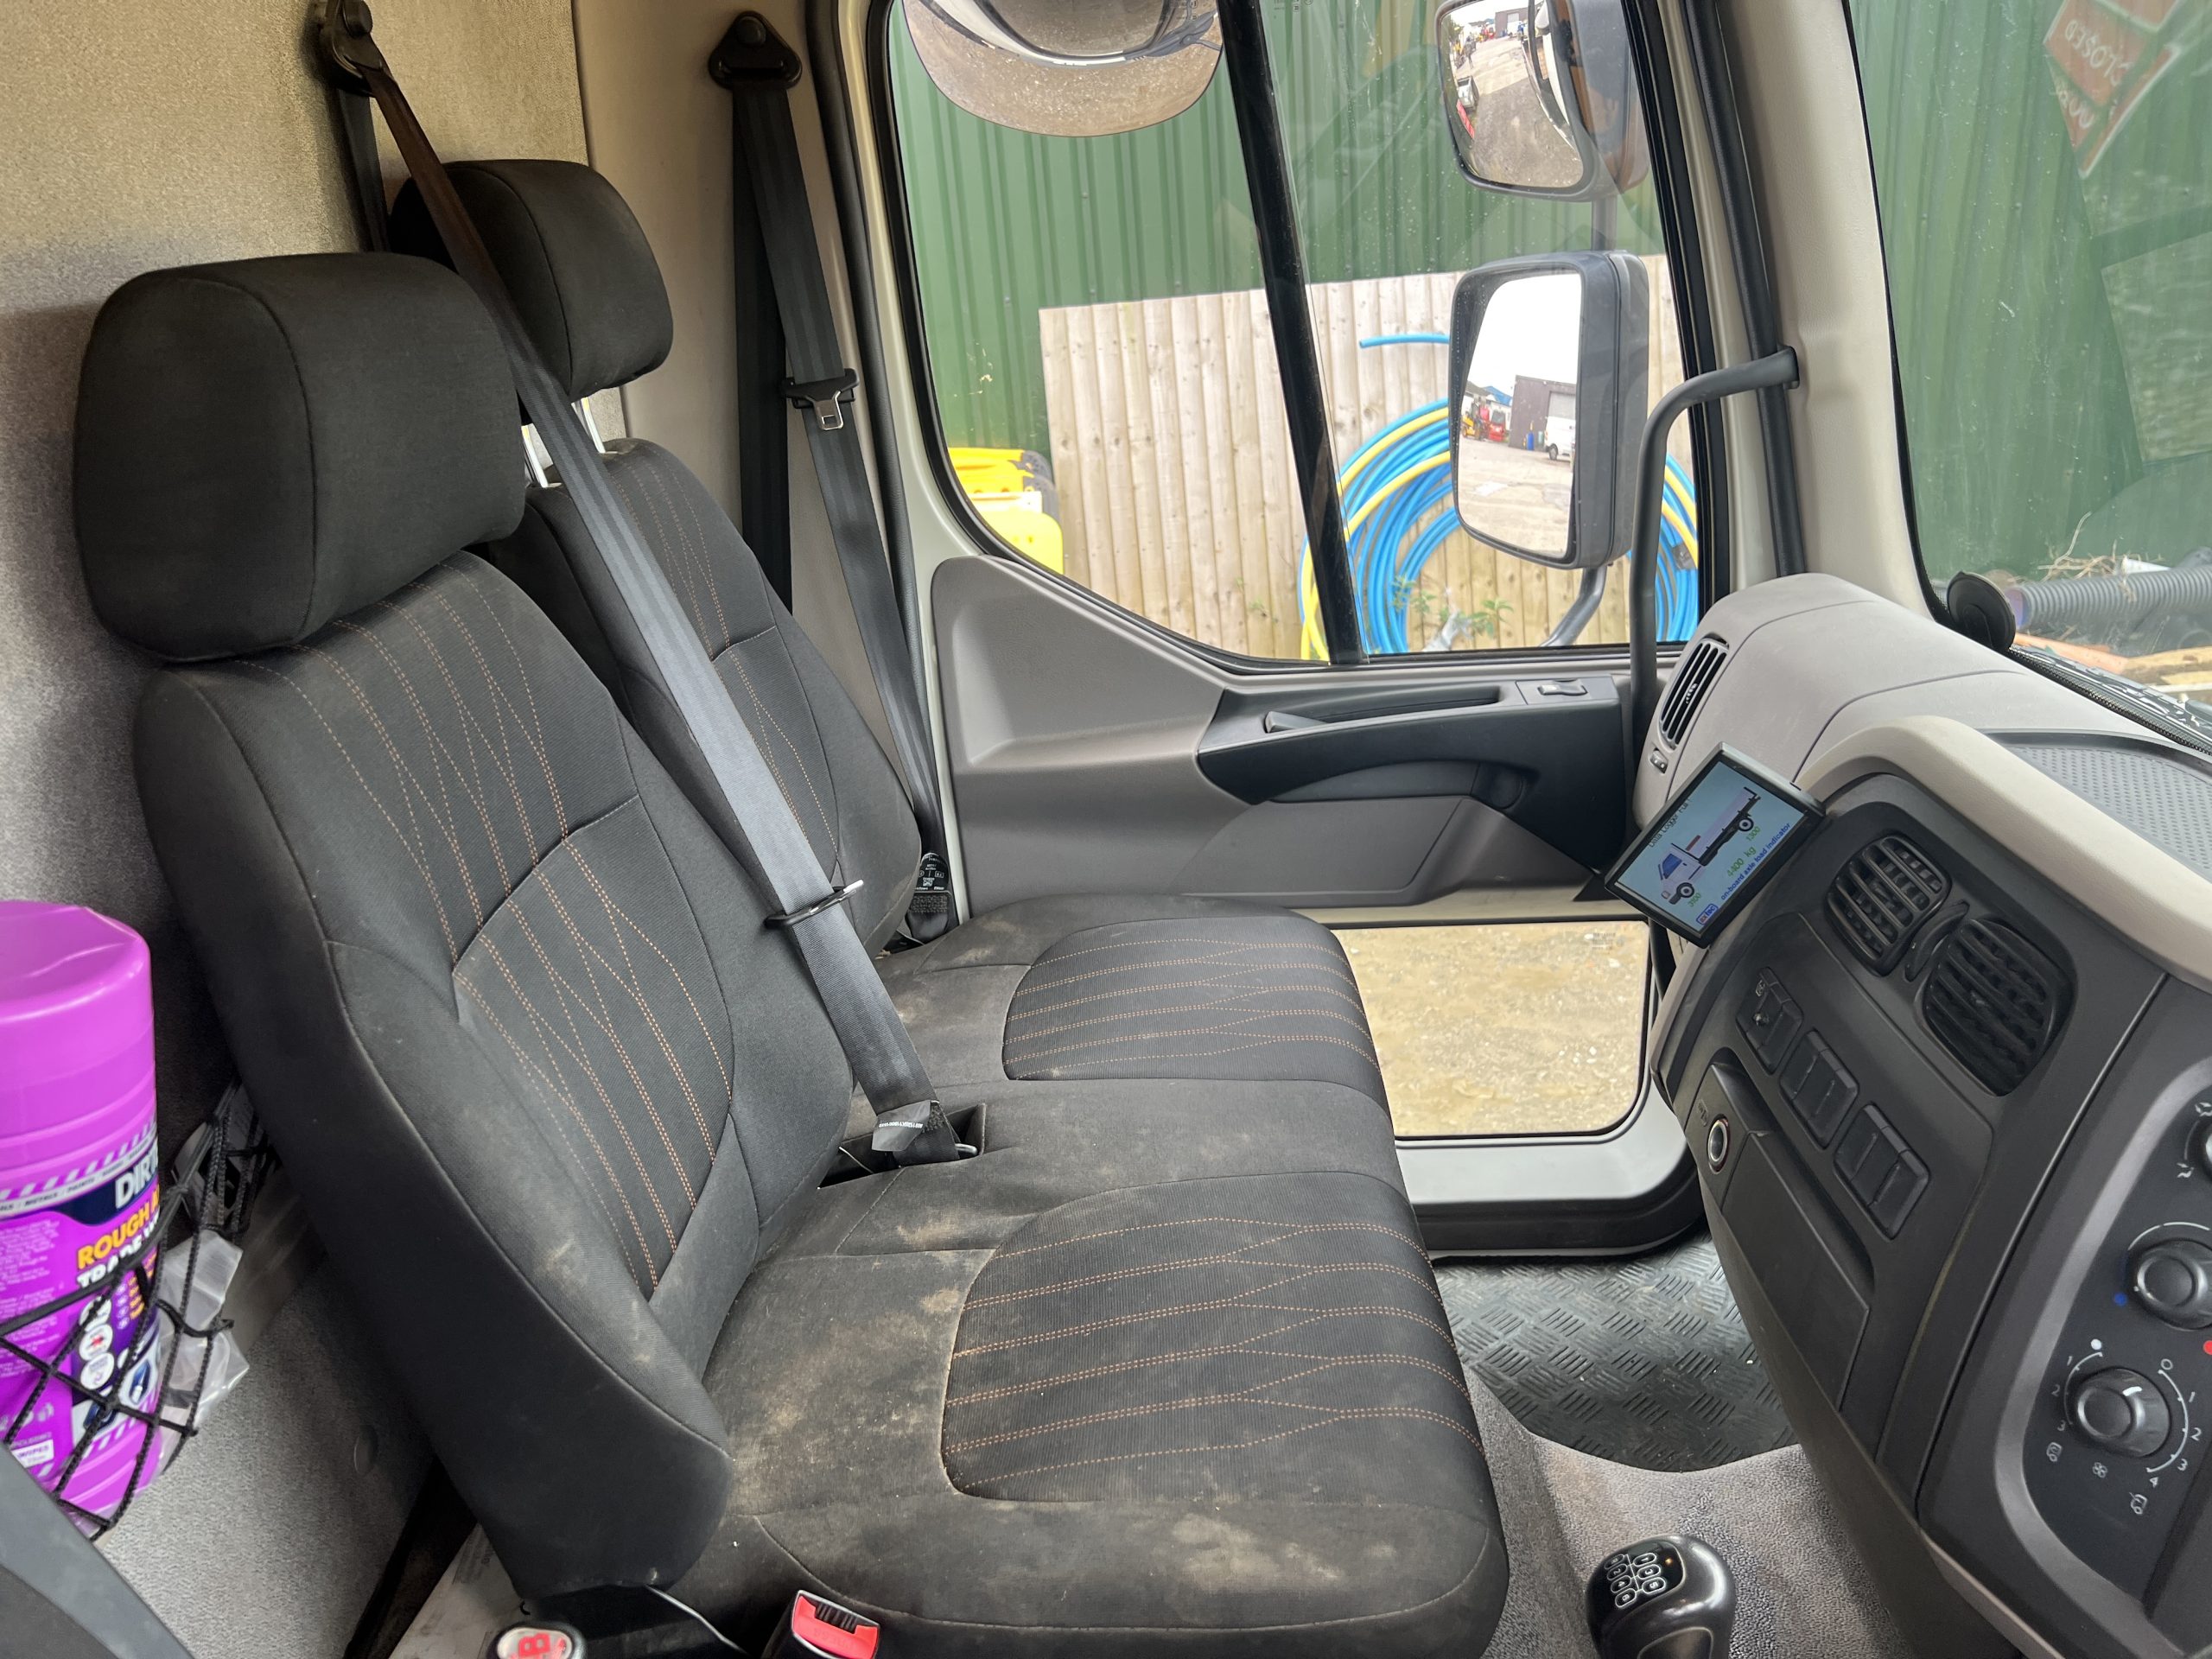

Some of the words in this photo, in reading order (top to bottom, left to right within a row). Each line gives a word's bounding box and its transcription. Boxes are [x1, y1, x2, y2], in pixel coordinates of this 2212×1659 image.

[2065, 20, 2133, 86] CLOSED
[1746, 826, 1760, 841] 1300
[1721, 874, 1745, 900] on-board
[1744, 861, 1756, 875] axle
[1754, 849, 1768, 862] load
[1765, 823, 1791, 849] indicator
[1727, 858, 1744, 876] 4400
[1745, 847, 1756, 857] kg
[78, 1201, 149, 1269] ROUGH
[2066, 1356, 2073, 1366] 1
[2051, 1384, 2061, 1396] 2
[2189, 1391, 2196, 1402] 1
[2057, 1420, 2066, 1432] 3
[2190, 1427, 2202, 1440] 2
[2177, 1459, 2189, 1471] 3
[2149, 1476, 2159, 1488] 4
